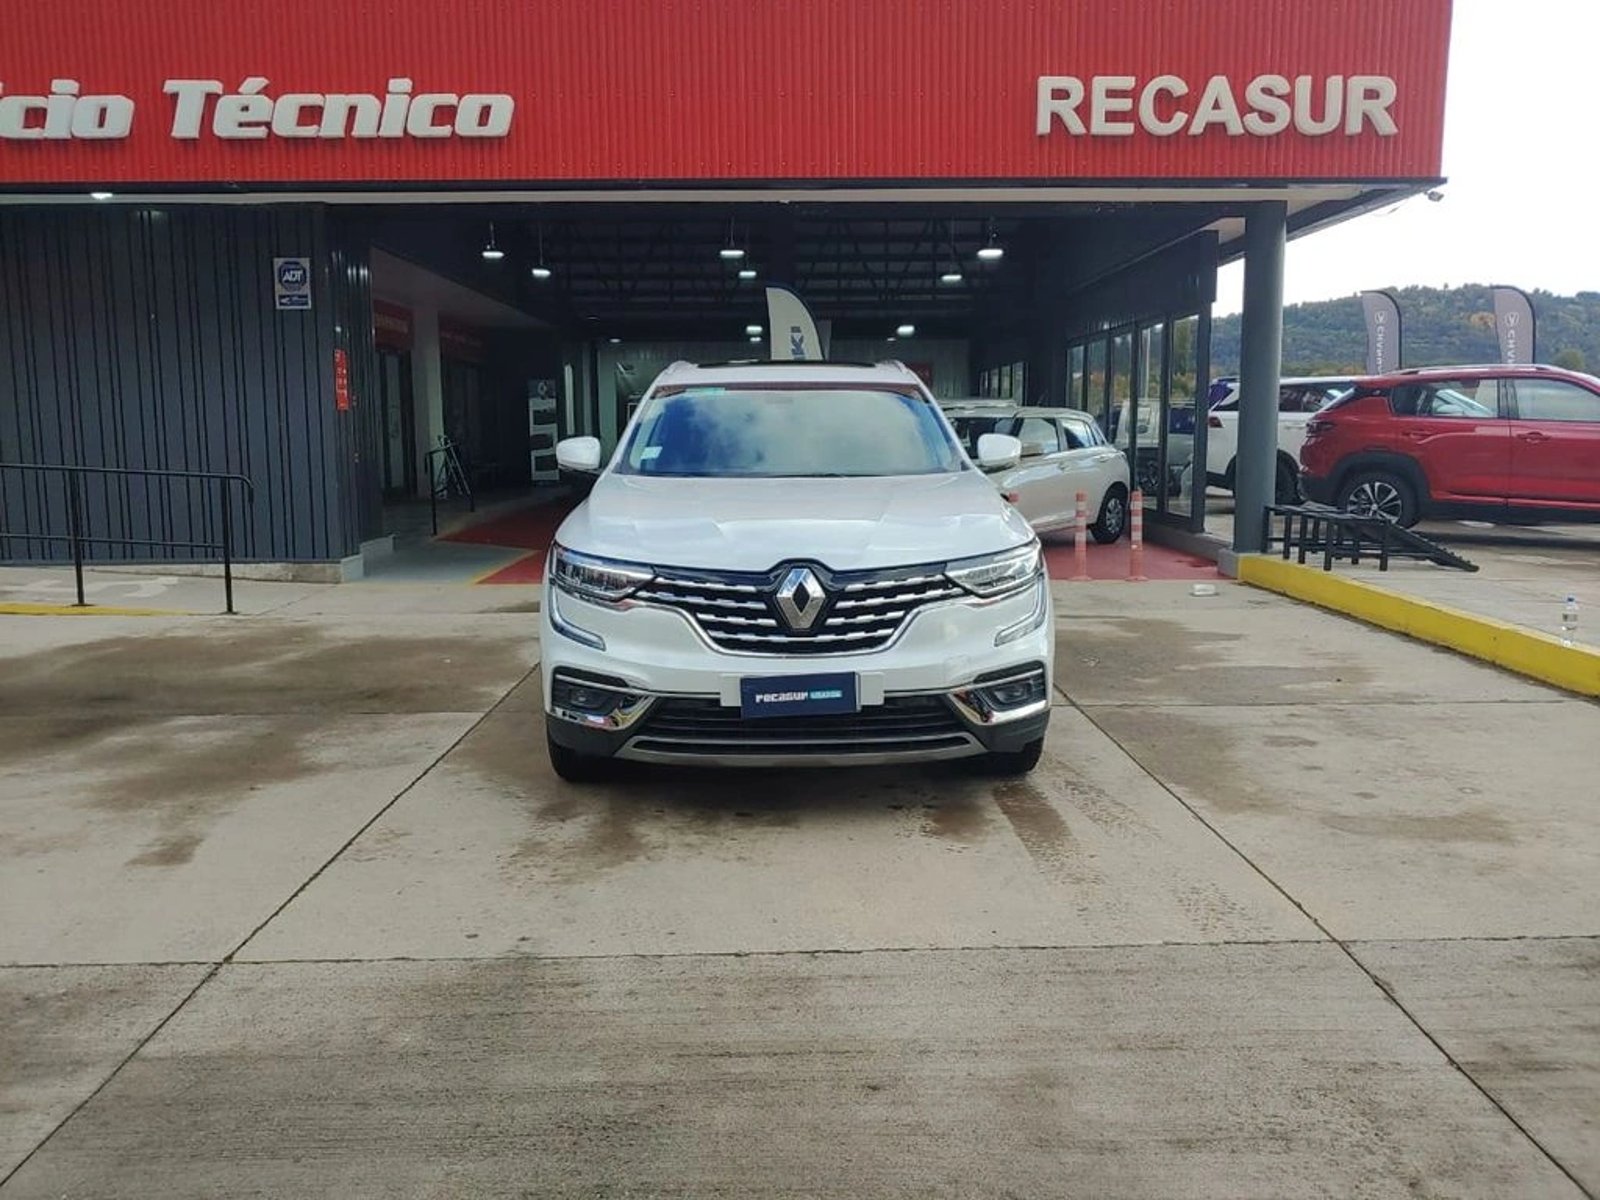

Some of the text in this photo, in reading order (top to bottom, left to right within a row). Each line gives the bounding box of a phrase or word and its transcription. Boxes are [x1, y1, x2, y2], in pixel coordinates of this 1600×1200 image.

[0, 77, 515, 139] cio Técnico
[1036, 74, 1399, 136] RECASUR
[282, 270, 304, 282] ADT
